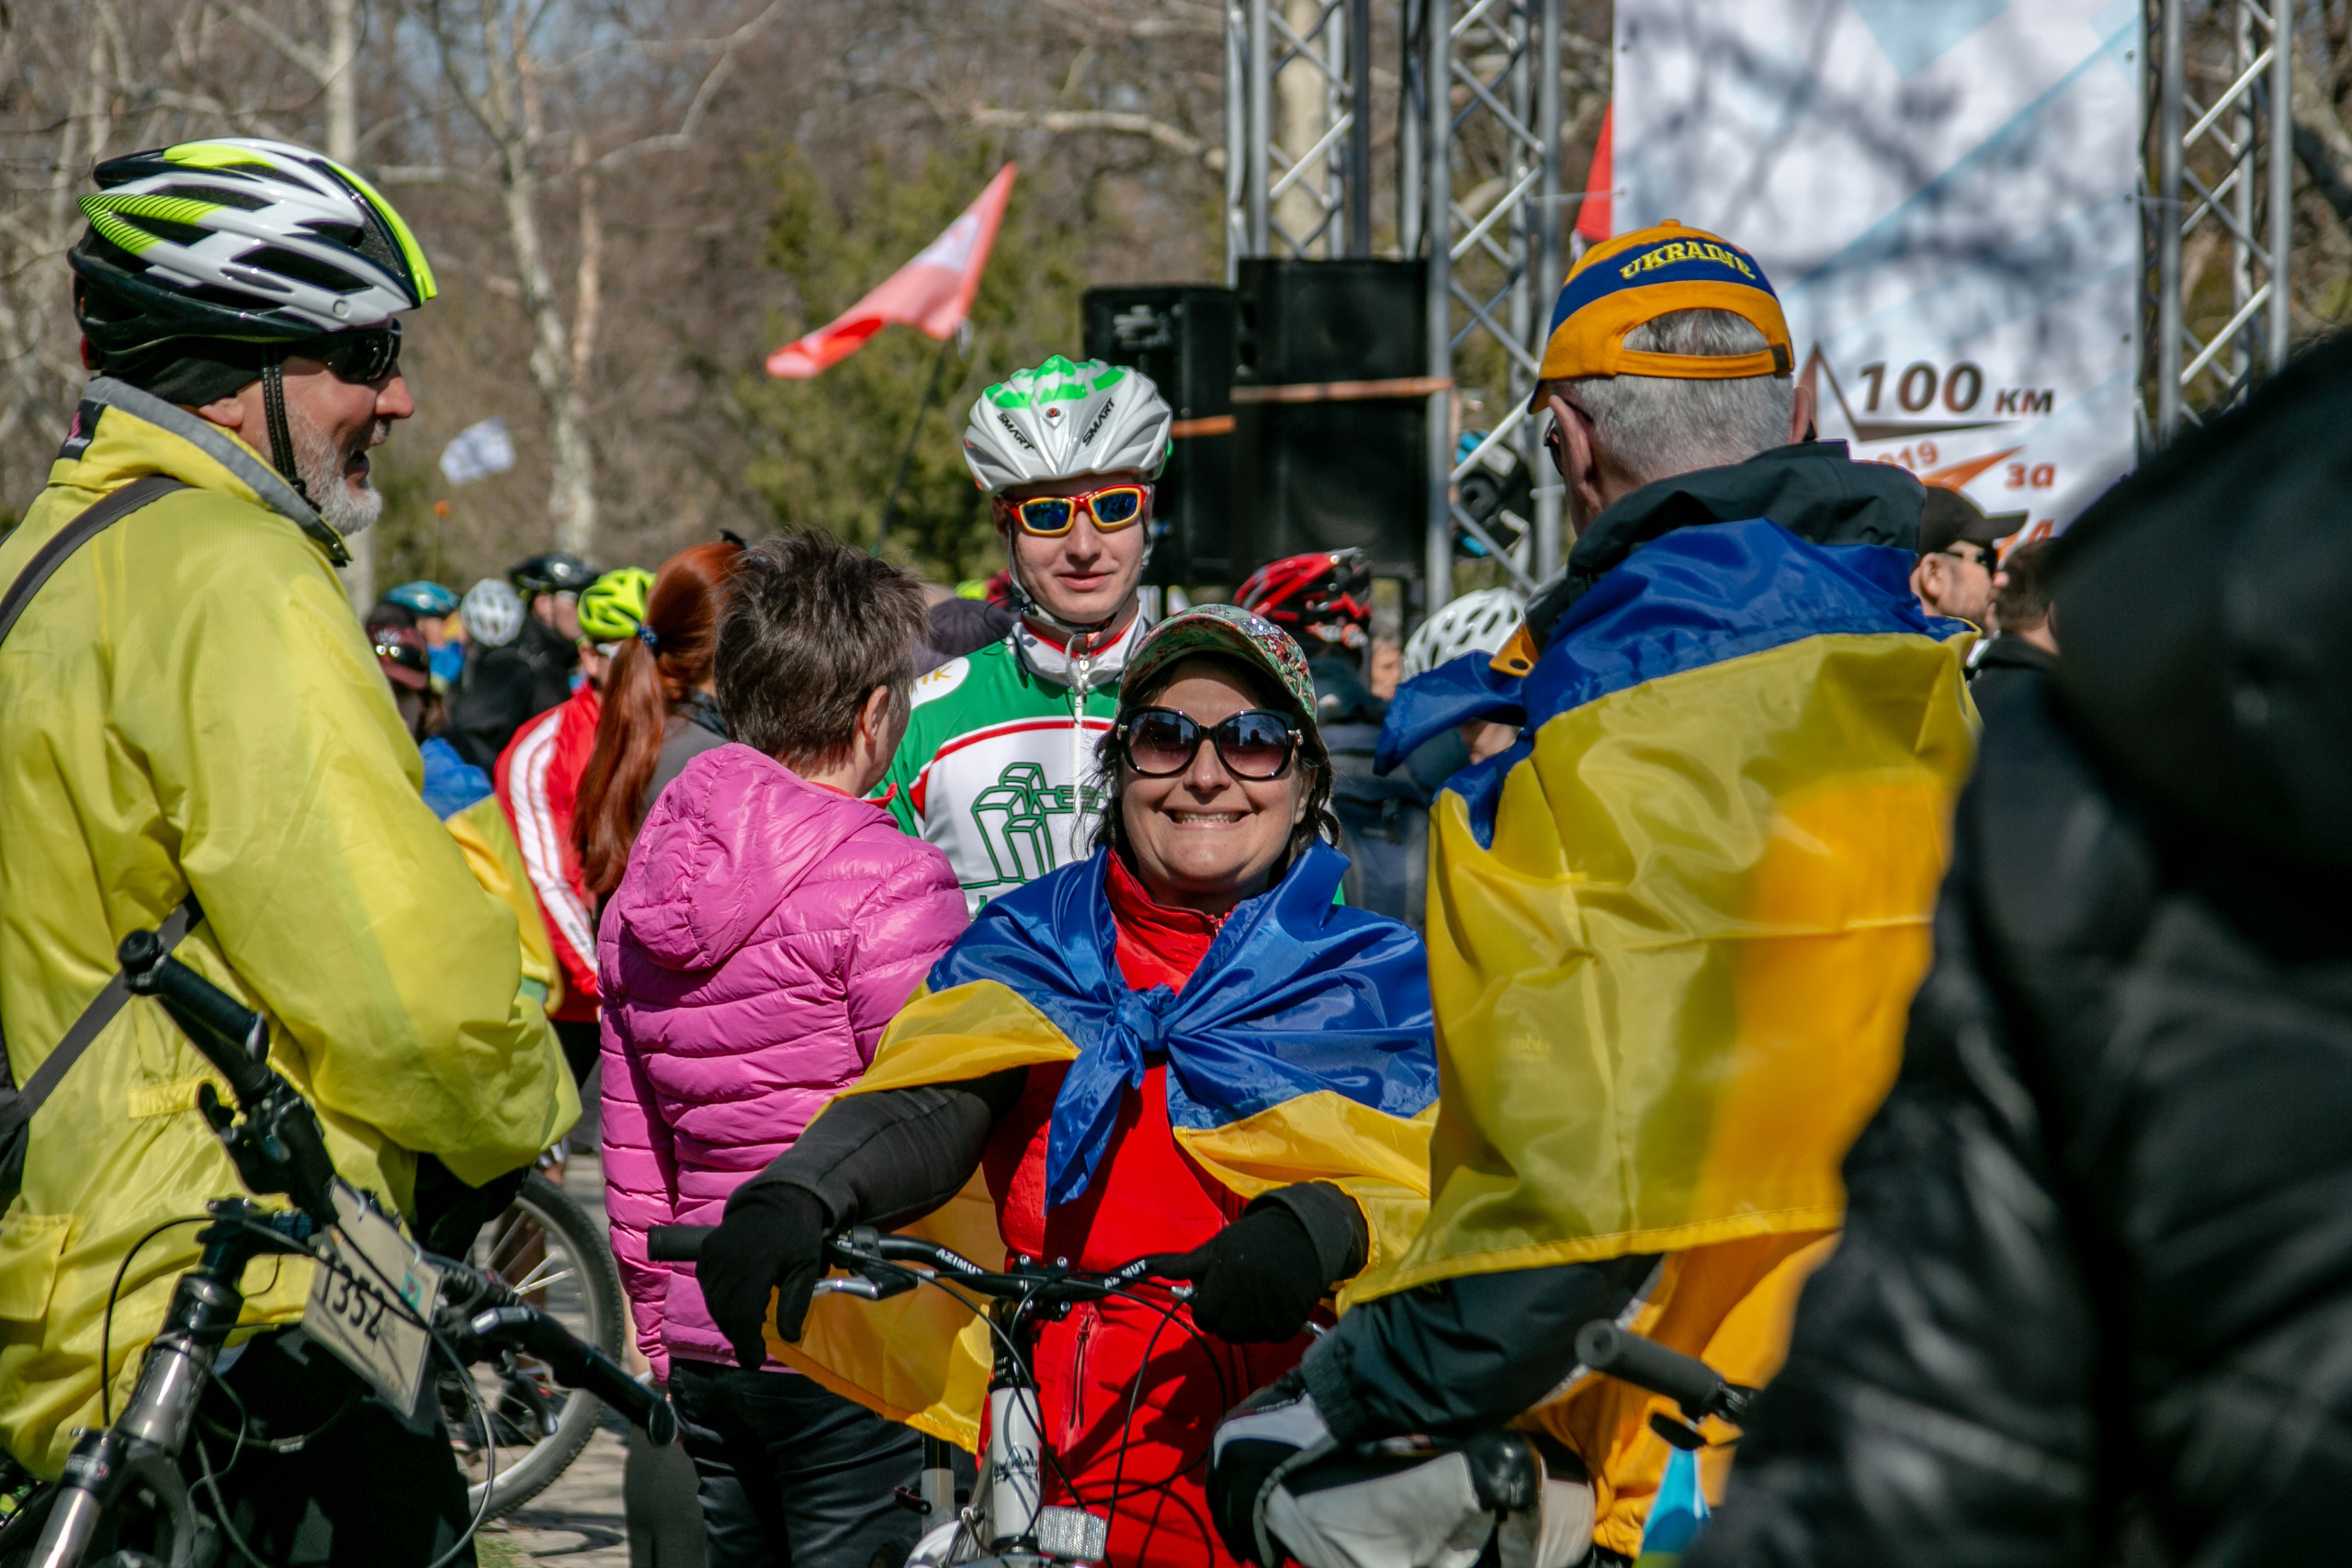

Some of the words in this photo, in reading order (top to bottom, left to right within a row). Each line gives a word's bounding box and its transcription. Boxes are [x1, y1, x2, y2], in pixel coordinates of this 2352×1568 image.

[1619, 241, 1756, 279] UKRAINE
[1860, 361, 1983, 412] 100
[997, 412, 1035, 449] SMART
[1082, 397, 1114, 446] SMART
[1103, 1258, 1147, 1291] AZMUT
